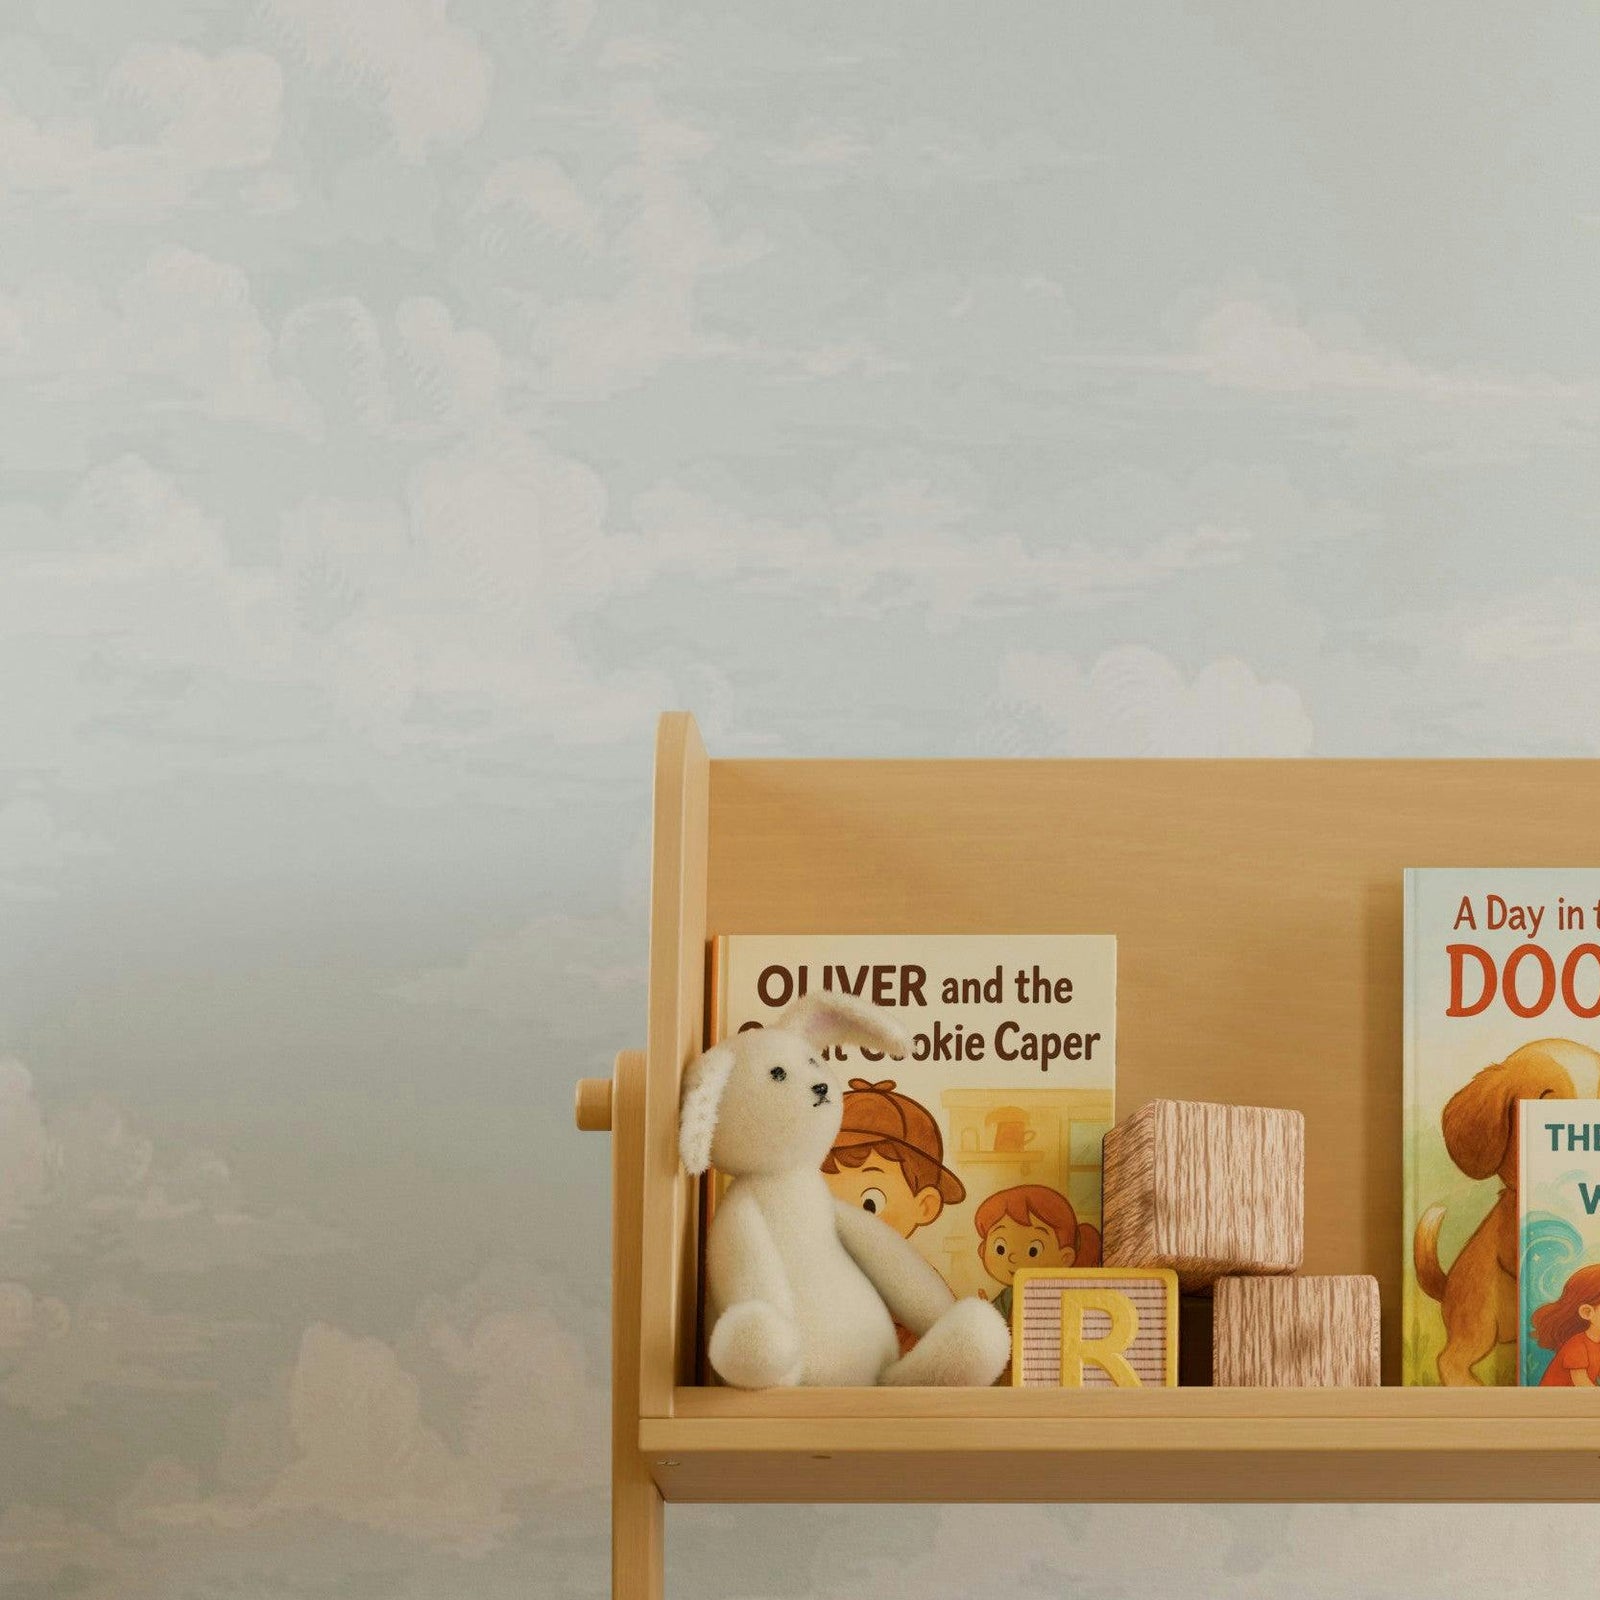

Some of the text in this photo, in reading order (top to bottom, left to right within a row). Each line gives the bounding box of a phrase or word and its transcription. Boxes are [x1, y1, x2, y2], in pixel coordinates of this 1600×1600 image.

[1453, 895, 1478, 931] A
[1486, 894, 1545, 938] Day
[1558, 897, 1585, 931] in
[941, 965, 1003, 1005] and
[1014, 965, 1074, 1004] the
[859, 1020, 985, 1062] okie
[994, 1021, 1101, 1072] Caper
[1059, 1288, 1141, 1387] R
